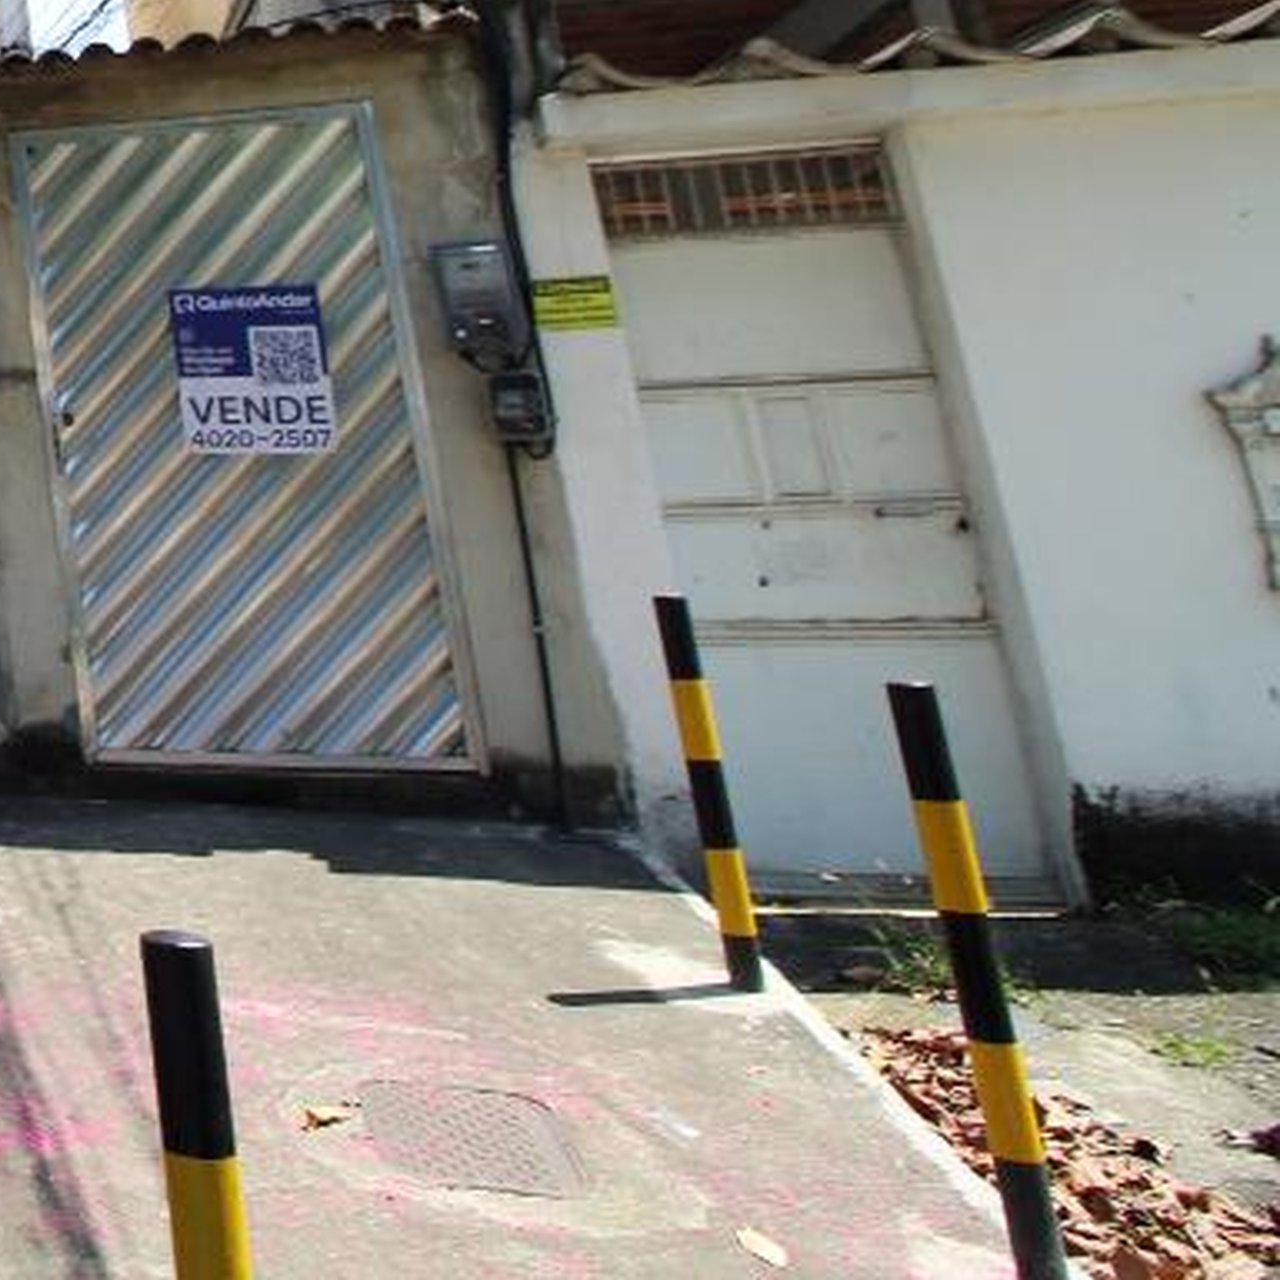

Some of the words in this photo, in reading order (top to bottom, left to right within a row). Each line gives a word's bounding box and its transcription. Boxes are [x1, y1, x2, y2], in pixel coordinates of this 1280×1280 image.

[196, 293, 313, 311] QuintoAndar
[189, 394, 330, 424] VENDE
[192, 429, 331, 448] 4020-2507
